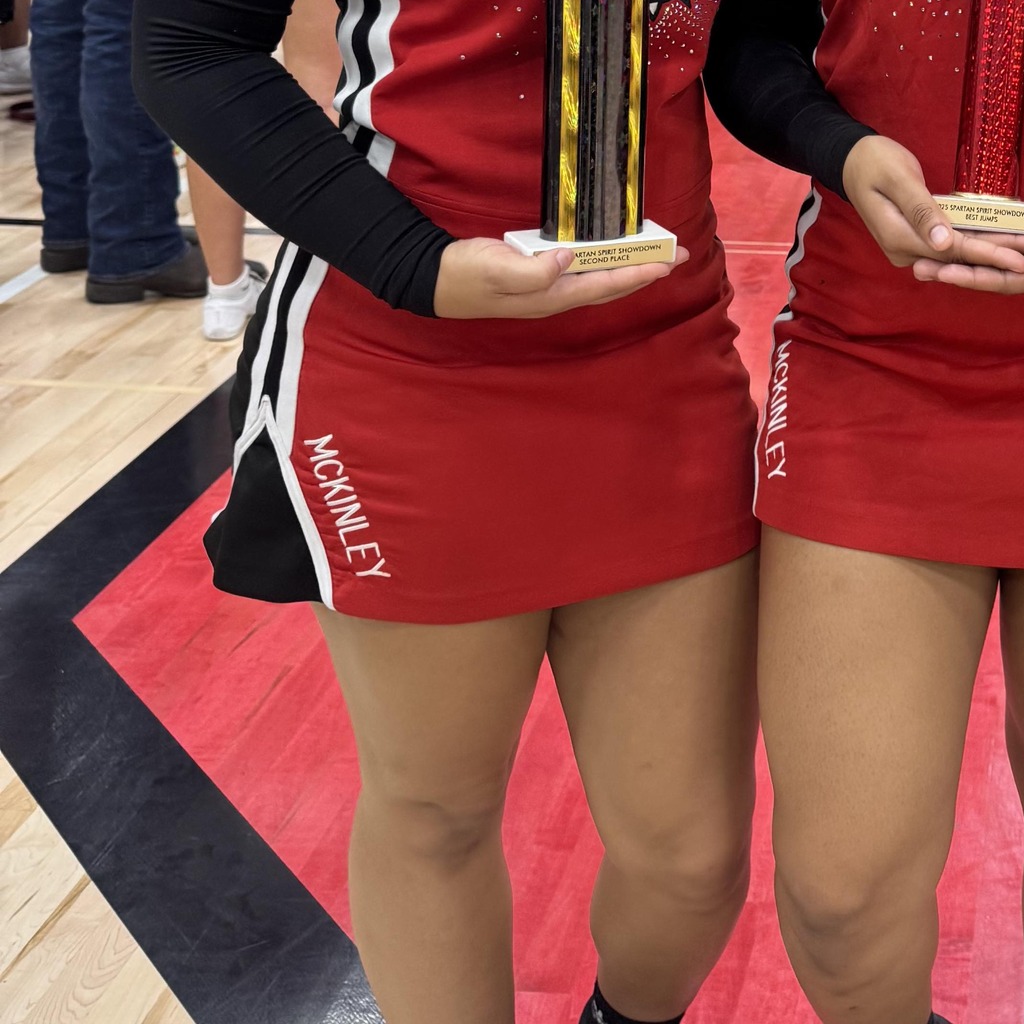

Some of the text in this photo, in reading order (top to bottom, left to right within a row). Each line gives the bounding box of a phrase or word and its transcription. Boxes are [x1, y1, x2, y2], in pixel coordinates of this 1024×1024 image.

[950, 204, 975, 213] SPARTAN
[980, 215, 998, 223] JUMPS
[575, 244, 661, 258] ARTAN SPIRIT SHOWDOWN
[579, 254, 629, 265] SECOND PLACE
[765, 339, 793, 479] MCKINLEY
[303, 433, 391, 578] MCKINLEY
